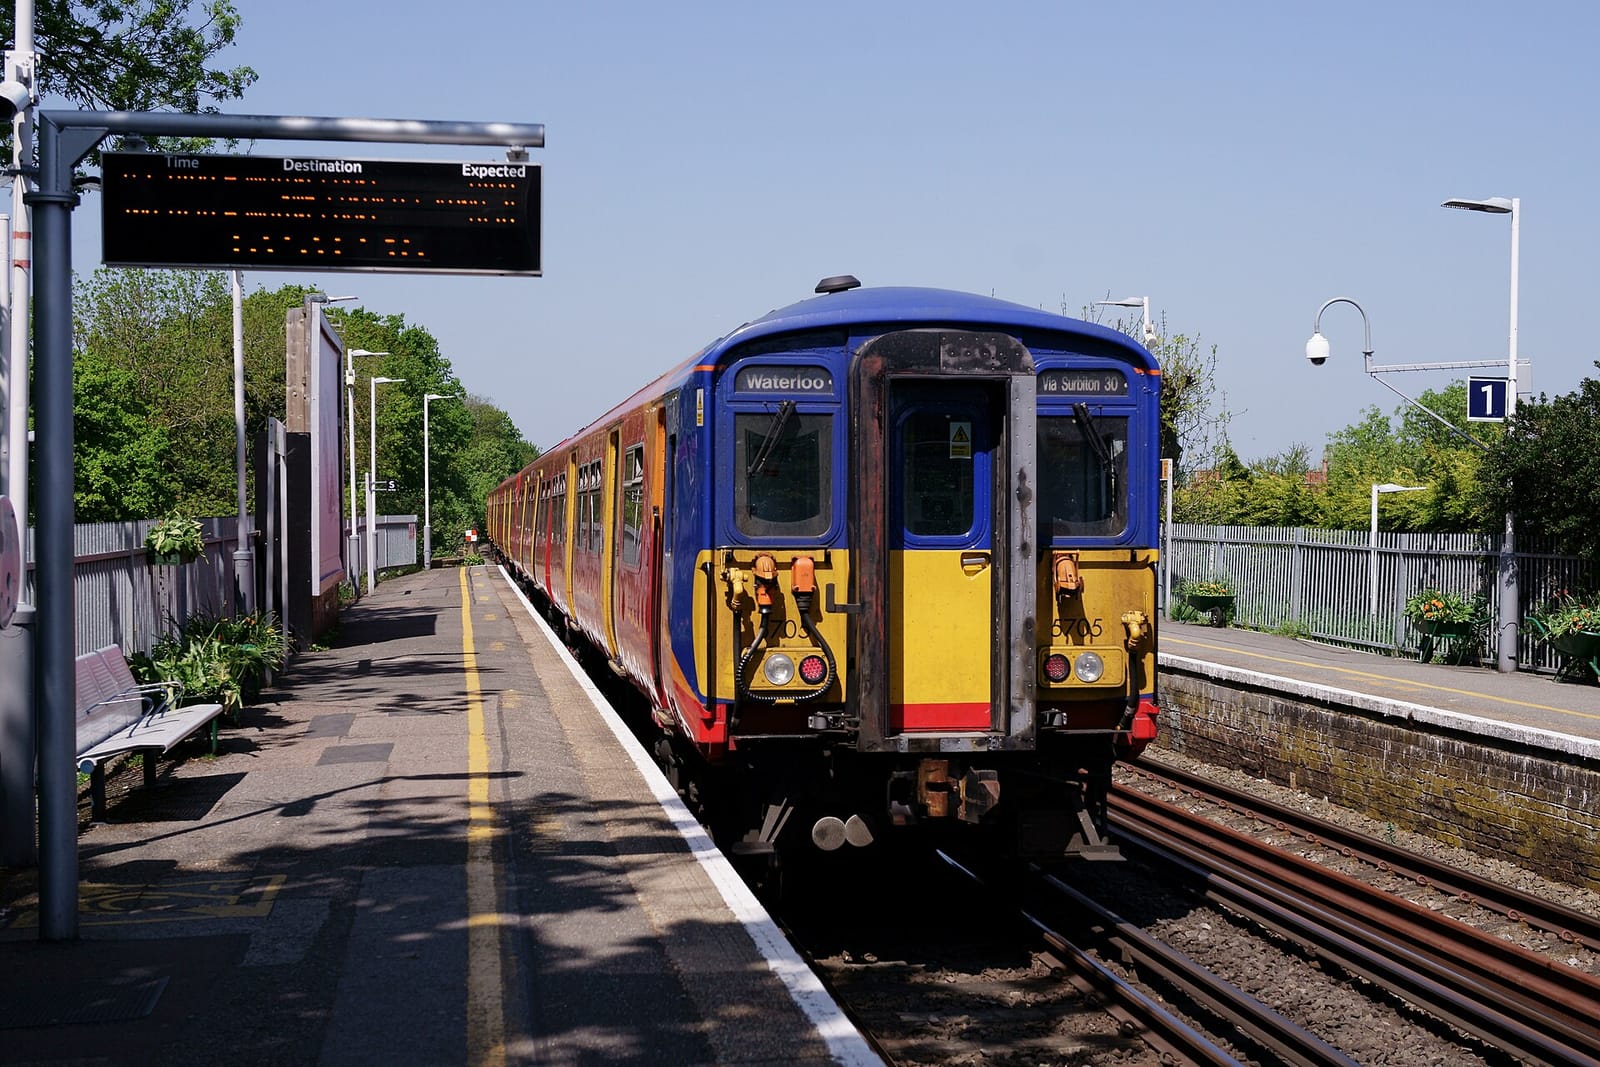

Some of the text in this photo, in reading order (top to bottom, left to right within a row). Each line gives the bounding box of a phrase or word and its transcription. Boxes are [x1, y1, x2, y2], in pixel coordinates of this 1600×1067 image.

[165, 155, 526, 179] Time Destination Expected
[746, 374, 824, 389] Waterloo
[1043, 376, 1118, 391] Via Surbiton 30
[1481, 384, 1493, 415] 1
[1051, 618, 1102, 637] 5705
